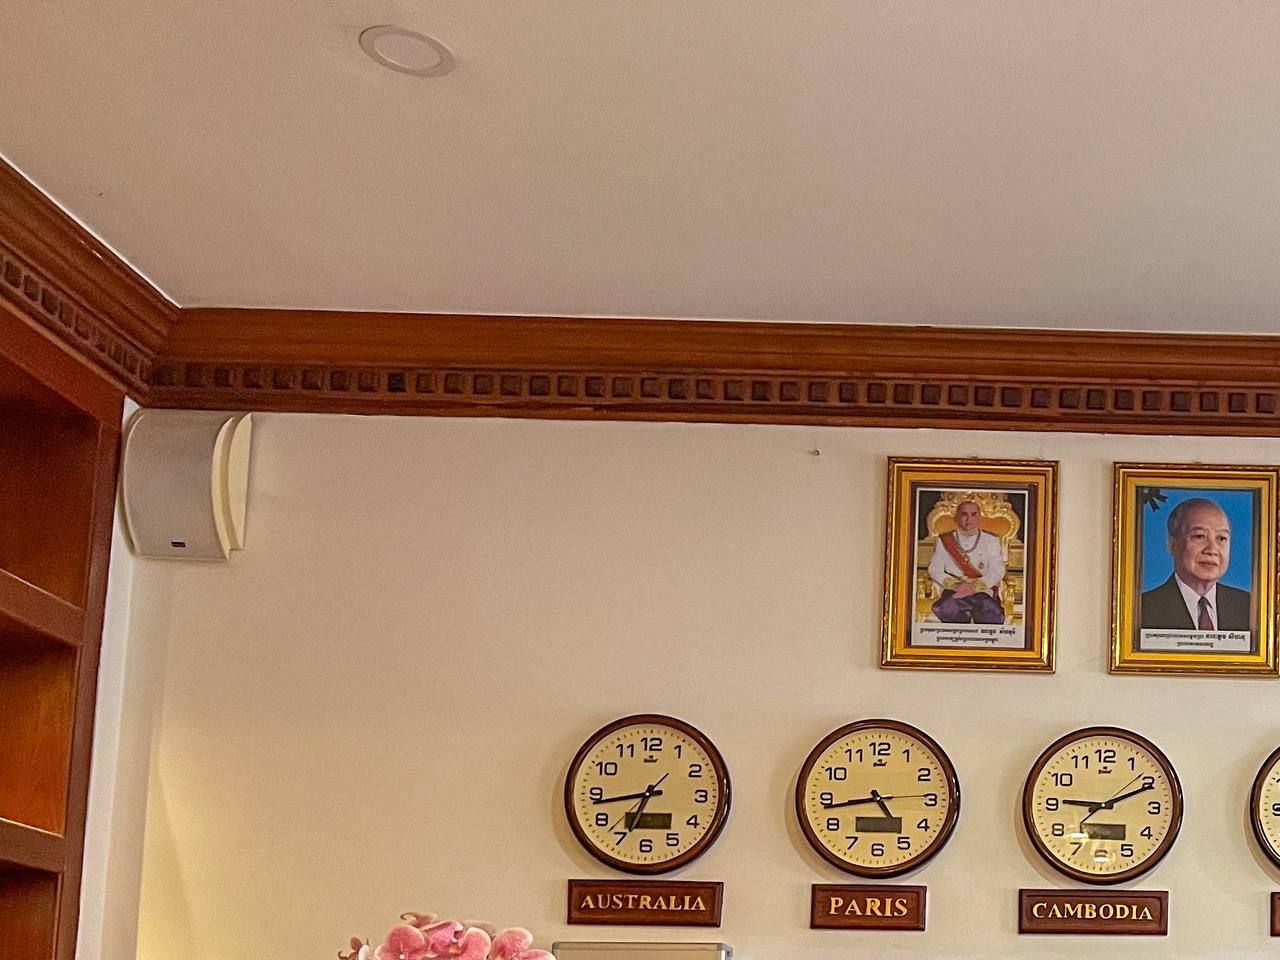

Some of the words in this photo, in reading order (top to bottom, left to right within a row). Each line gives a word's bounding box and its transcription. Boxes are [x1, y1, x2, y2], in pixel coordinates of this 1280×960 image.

[615, 744, 634, 758] 11
[640, 737, 663, 751] 12
[869, 742, 891, 756] 12
[674, 745, 681, 759] 1
[844, 749, 863, 763] 11
[902, 749, 910, 763] 1
[1094, 749, 1116, 763] 12
[595, 761, 618, 776] 10
[1071, 755, 1089, 769] 11
[1127, 757, 1135, 771] 1
[688, 764, 702, 778] 2
[825, 767, 847, 781] 10
[917, 768, 931, 782] 2
[1051, 773, 1073, 786] 10
[1142, 776, 1155, 789] 2
[589, 787, 603, 801] 9
[694, 789, 708, 803] 3
[819, 792, 833, 805] 9
[924, 793, 937, 807] 3
[1045, 797, 1059, 811] 9
[1147, 801, 1160, 815] 3
[595, 812, 608, 826] 8
[686, 815, 700, 829] 4
[827, 818, 840, 831] 8
[916, 818, 930, 832] 4
[1052, 823, 1064, 837] 8
[1140, 826, 1153, 840] 4
[613, 831, 627, 846] 7
[666, 833, 679, 846] 5
[845, 836, 859, 850] 7
[897, 836, 911, 850] 5
[639, 839, 653, 853] 6
[871, 843, 884, 856] 6
[1069, 842, 1083, 855] 7
[1120, 844, 1134, 857] 5
[580, 893, 706, 911] AUSTRALIA
[829, 896, 908, 917] PARIS
[1032, 902, 1153, 920] CAMBODIA
